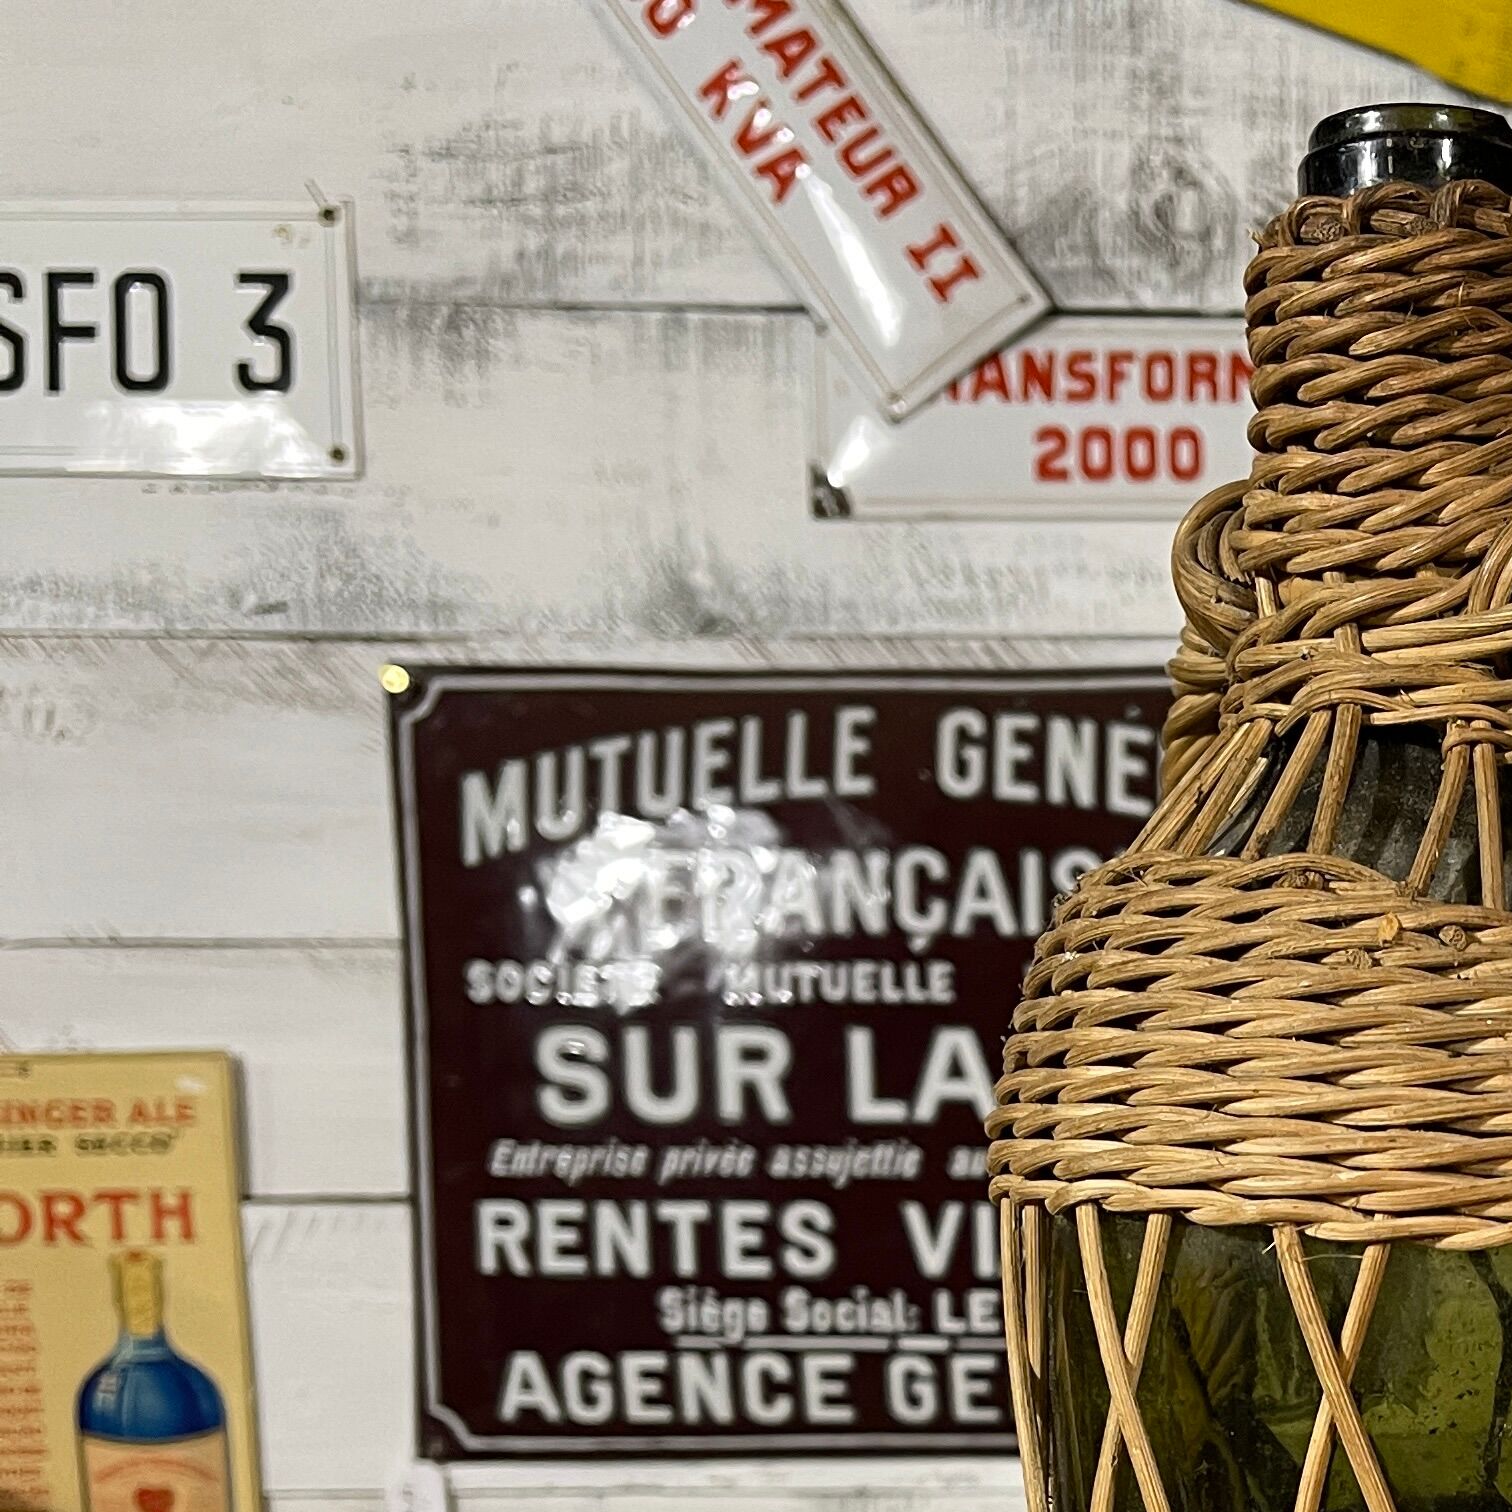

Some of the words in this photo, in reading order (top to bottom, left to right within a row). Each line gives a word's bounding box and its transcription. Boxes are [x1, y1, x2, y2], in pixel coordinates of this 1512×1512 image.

[701, 58, 804, 203] KVA
[235, 272, 293, 393] 3
[1033, 425, 1201, 482] 2000
[461, 707, 877, 868] MUTUELLE
[714, 959, 956, 1004] MUTUELLE
[536, 1024, 795, 1125] SUR
[846, 1025, 998, 1124] LA
[130, 1097, 197, 1128] ALE
[489, 1138, 650, 1187] Entreprise
[476, 1199, 836, 1279] RENTES
[902, 1201, 998, 1280] VI
[658, 1285, 769, 1345] Siège
[934, 1288, 1001, 1333] LE
[499, 1350, 856, 1425] AGENCE
[886, 1353, 1002, 1425] GE
